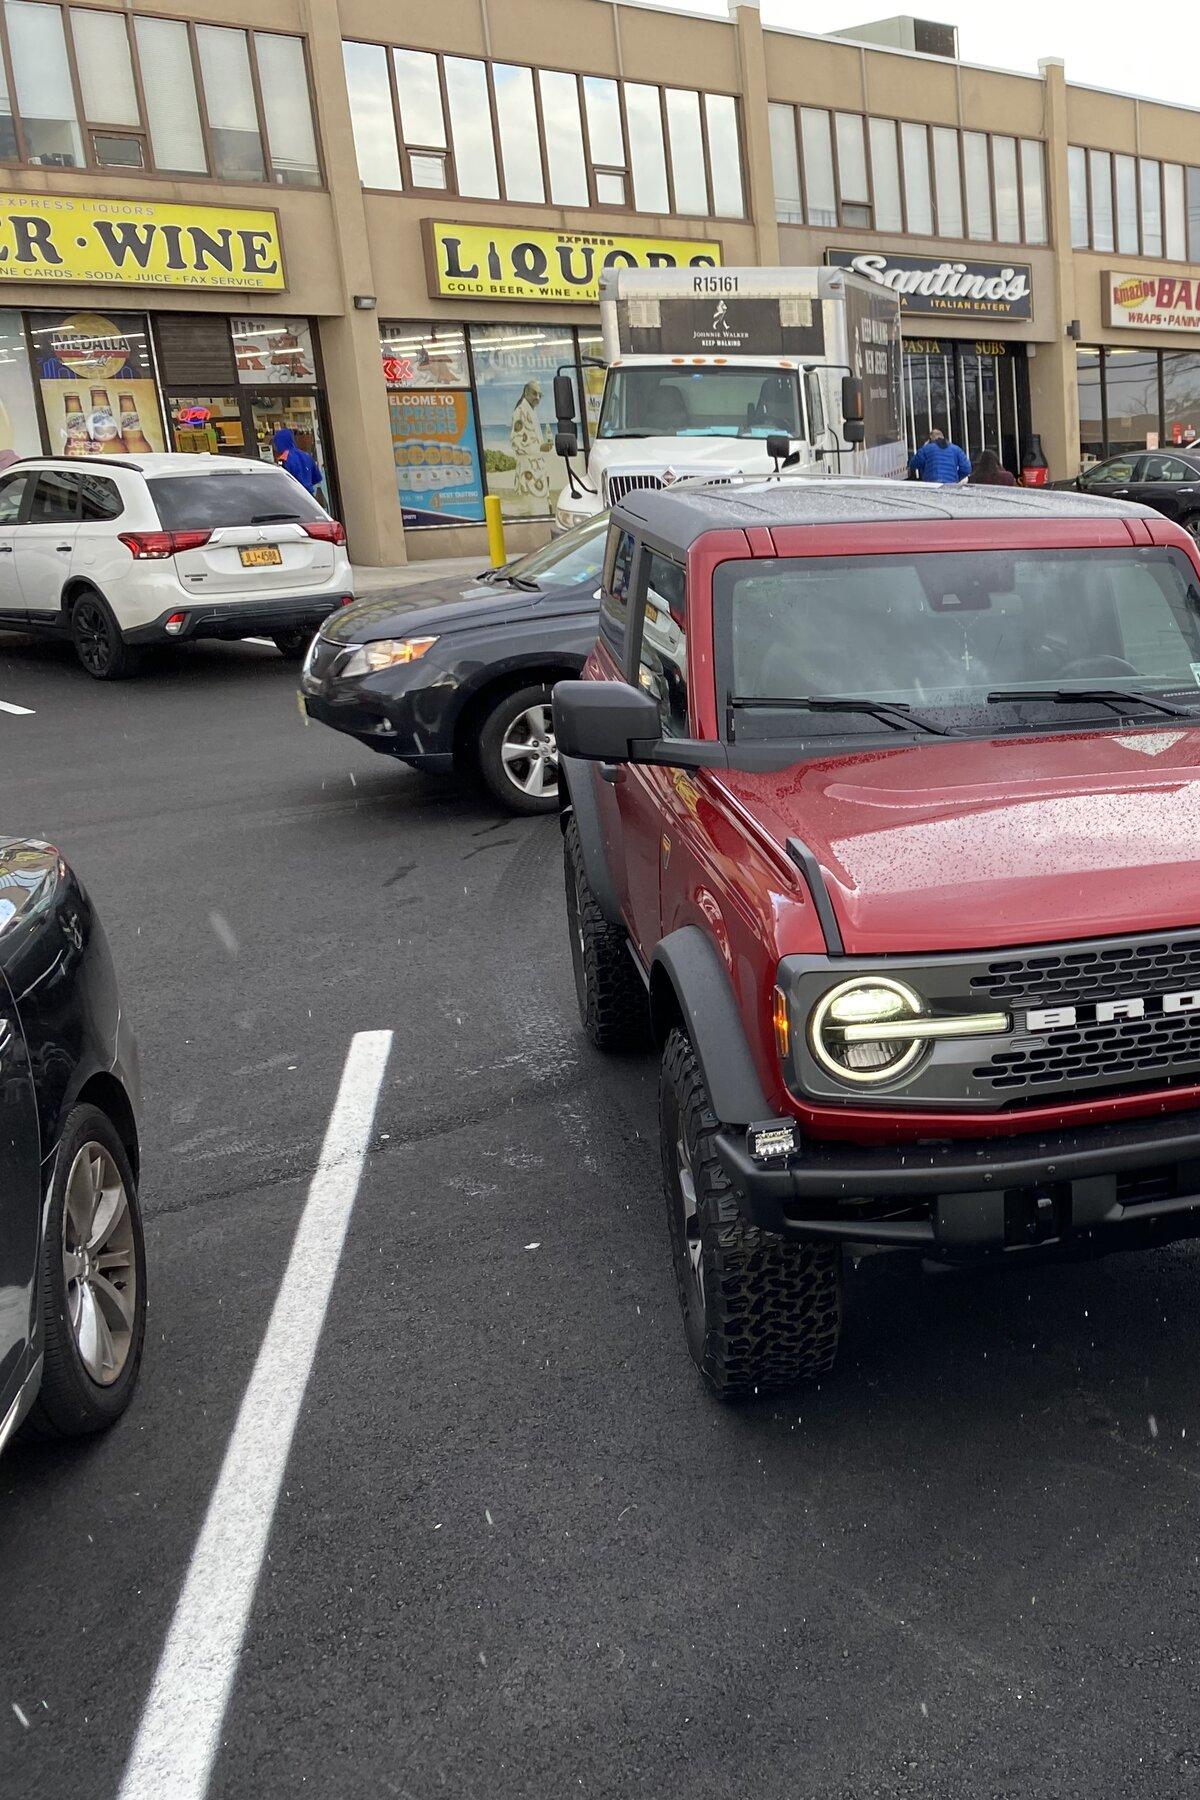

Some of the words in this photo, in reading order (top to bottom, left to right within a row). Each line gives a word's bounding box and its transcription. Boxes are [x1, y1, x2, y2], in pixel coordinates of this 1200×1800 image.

[82, 203, 155, 216] LIQUORS
[0, 215, 64, 265] R
[93, 220, 278, 275] WINE
[557, 235, 614, 246] EXPRESS
[23, 267, 73, 278] CARDS
[84, 270, 123, 280] SODA
[134, 273, 171, 283] JUICE
[182, 275, 207, 284] FAX
[211, 276, 264, 287] SERVICE
[693, 276, 739, 293] R15161
[850, 254, 1031, 301] Santino's
[447, 282, 484, 294] COLD
[490, 284, 524, 295] BEER
[539, 287, 571, 297] WINE
[930, 298, 971, 310] ITALIAN
[974, 302, 1012, 312] EATERY
[1128, 311, 1162, 325] WRAPS
[53, 332, 130, 351] MEDALLA
[902, 340, 941, 353] PASTA
[975, 341, 1006, 355] SUBS
[390, 395, 438, 406] ELCOME
[438, 396, 455, 405] TO
[177, 408, 212, 421] Open
